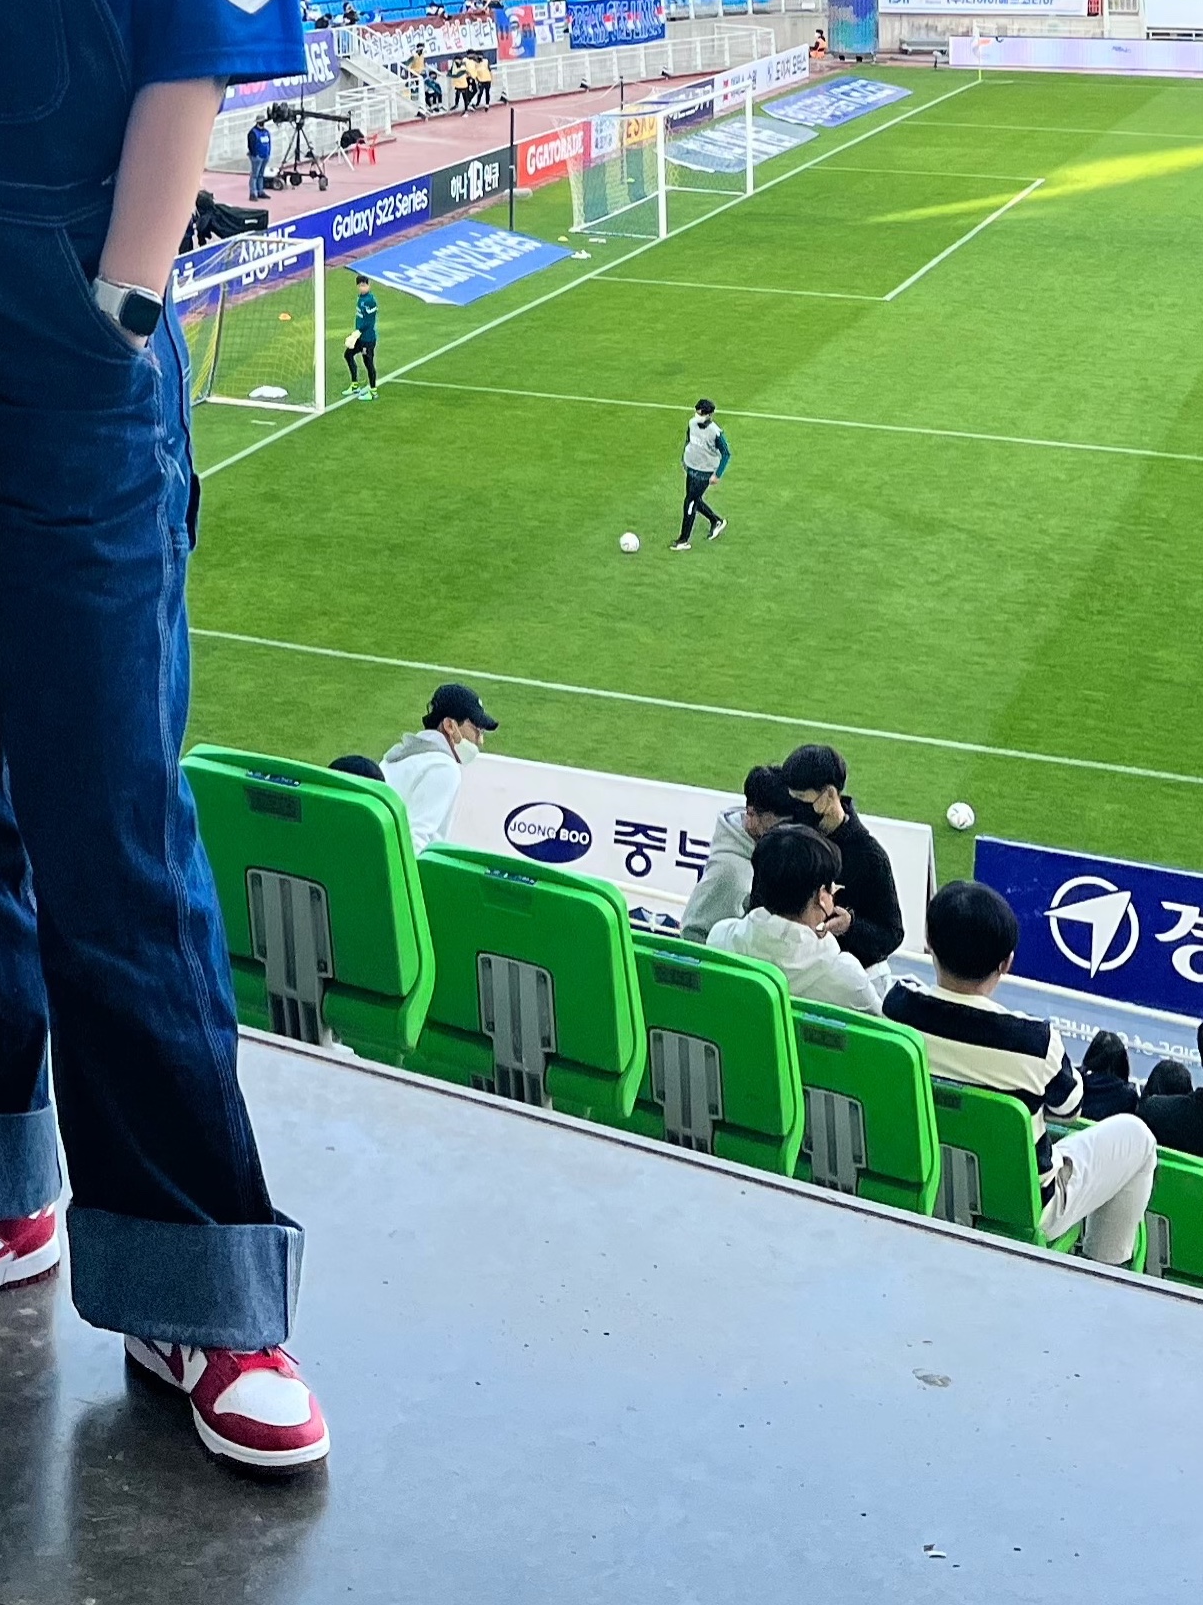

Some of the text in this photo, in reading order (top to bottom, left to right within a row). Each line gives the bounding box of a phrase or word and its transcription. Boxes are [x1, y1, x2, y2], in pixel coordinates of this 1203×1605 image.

[332, 185, 428, 242] Galaxy S22 Series
[509, 820, 590, 845] JOONG BOO
